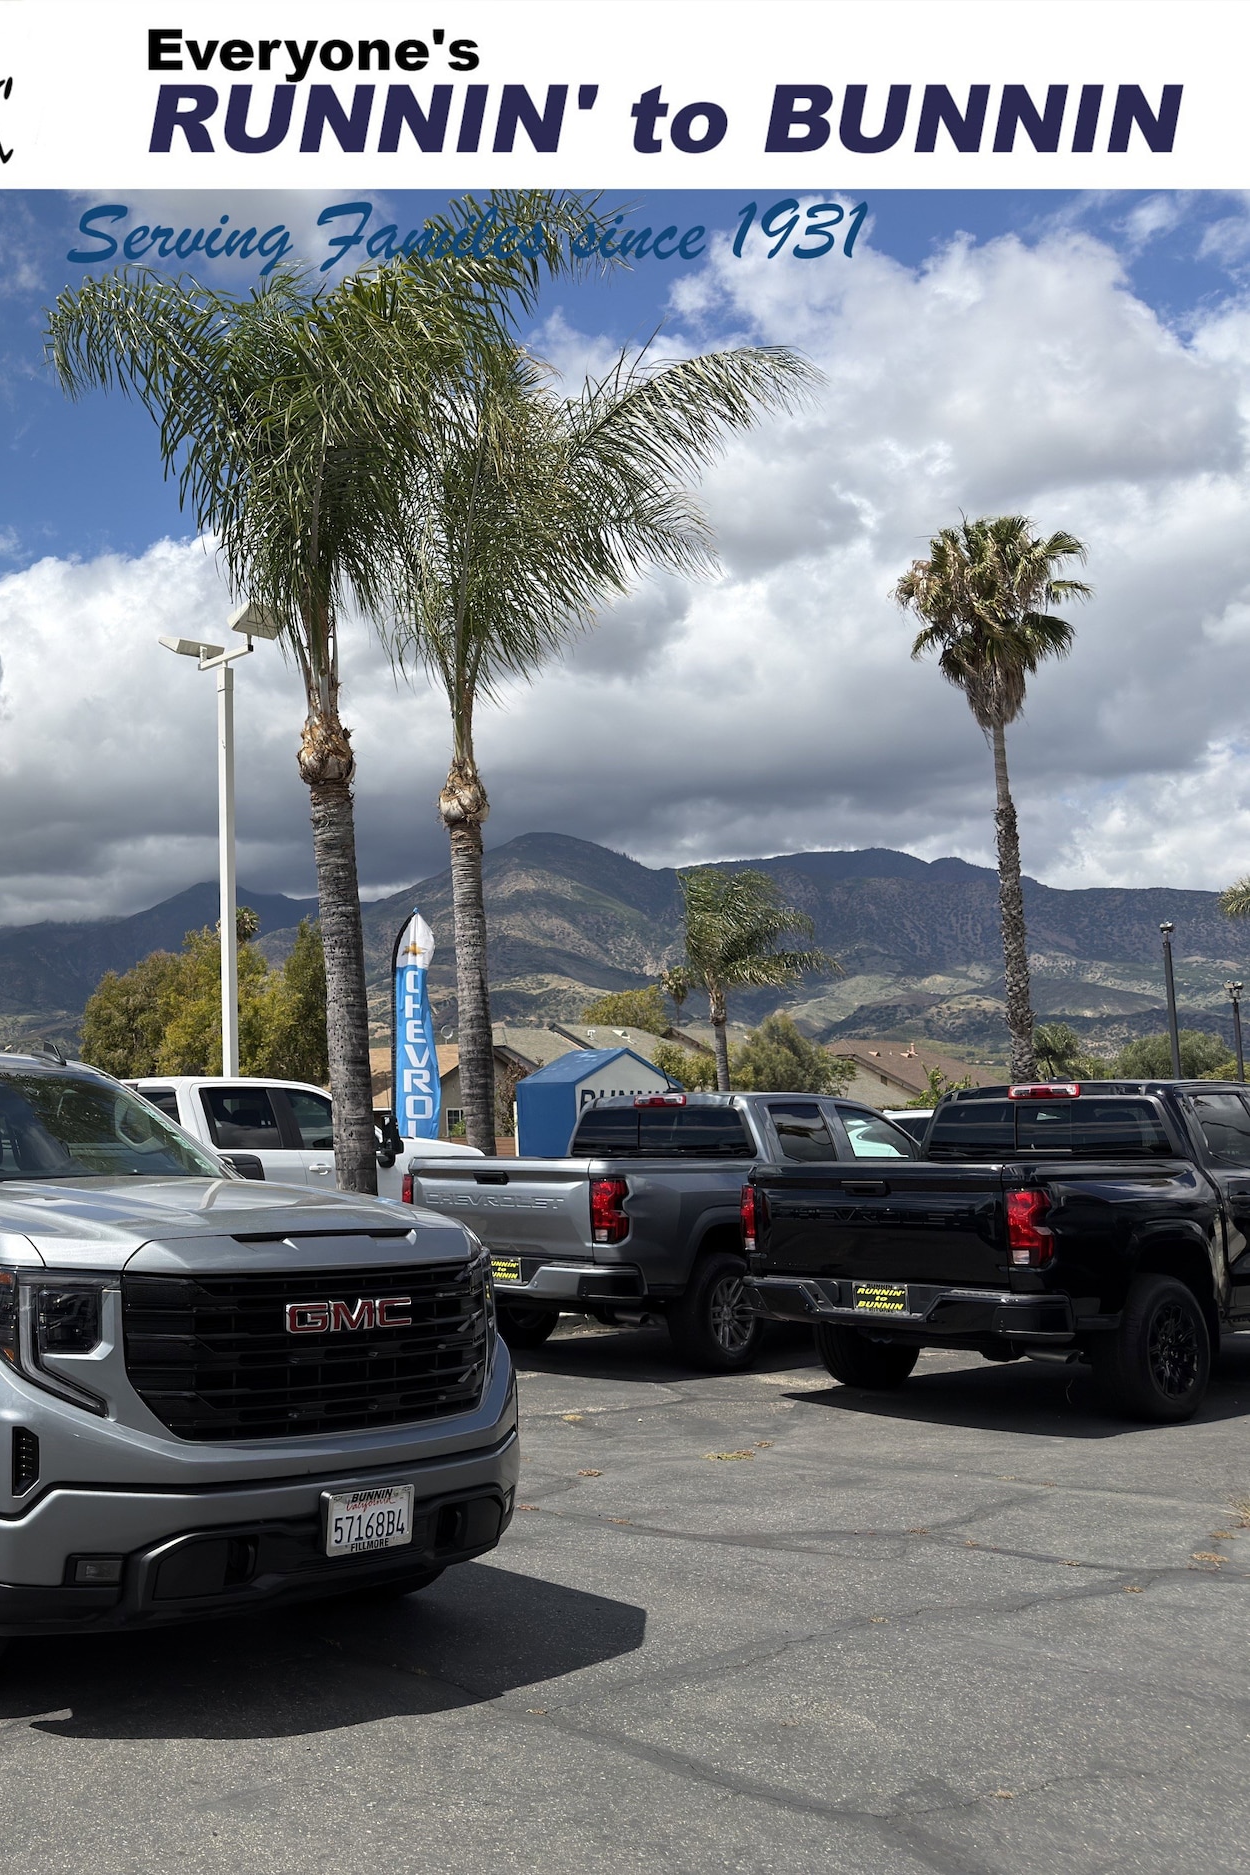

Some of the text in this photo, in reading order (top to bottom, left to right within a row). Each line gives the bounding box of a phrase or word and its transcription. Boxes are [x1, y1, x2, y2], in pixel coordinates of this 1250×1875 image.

[425, 1192, 565, 1210] CHEVROLET
[491, 1260, 519, 1268] UNNIN'
[492, 1271, 518, 1279] UNNIN
[857, 1287, 905, 1297] RUNNIN'
[857, 1300, 904, 1310] BUNNIN
[285, 1297, 412, 1334] GMC
[351, 1488, 394, 1503] BUNNIN
[334, 1508, 405, 1544] 57168B4
[350, 1537, 390, 1553] FILLMORE
